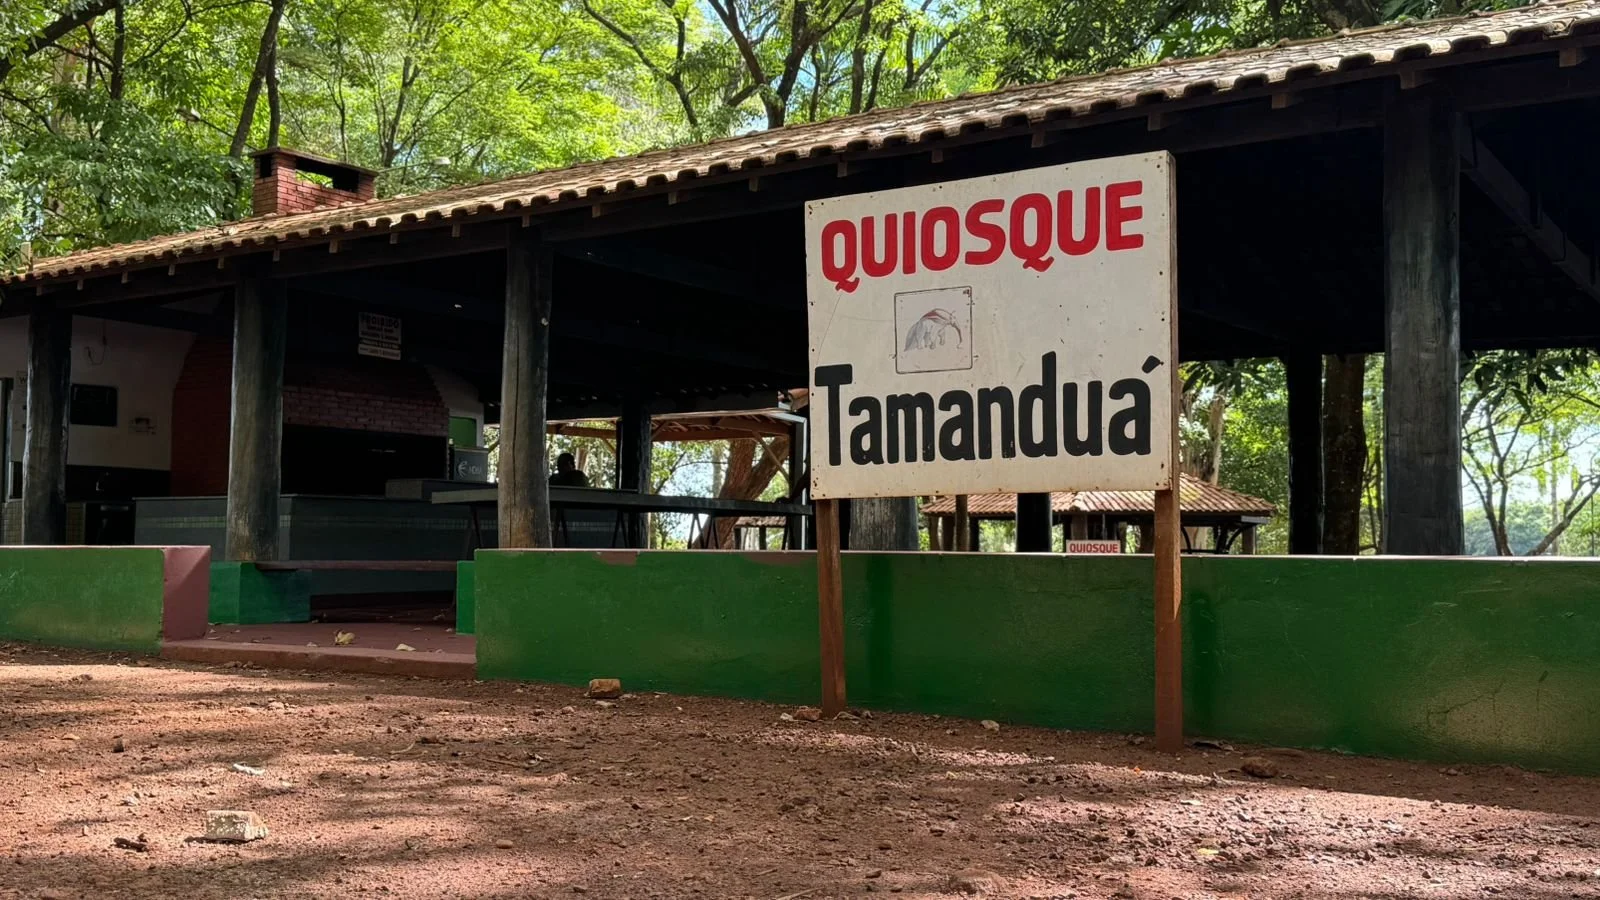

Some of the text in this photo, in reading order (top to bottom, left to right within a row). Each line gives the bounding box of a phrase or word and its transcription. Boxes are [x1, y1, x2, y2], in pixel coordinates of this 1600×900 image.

[821, 180, 1143, 293] QUIOSQUE
[815, 351, 1163, 466] Tamanduá
[1070, 543, 1118, 553] QUIOSQUE
